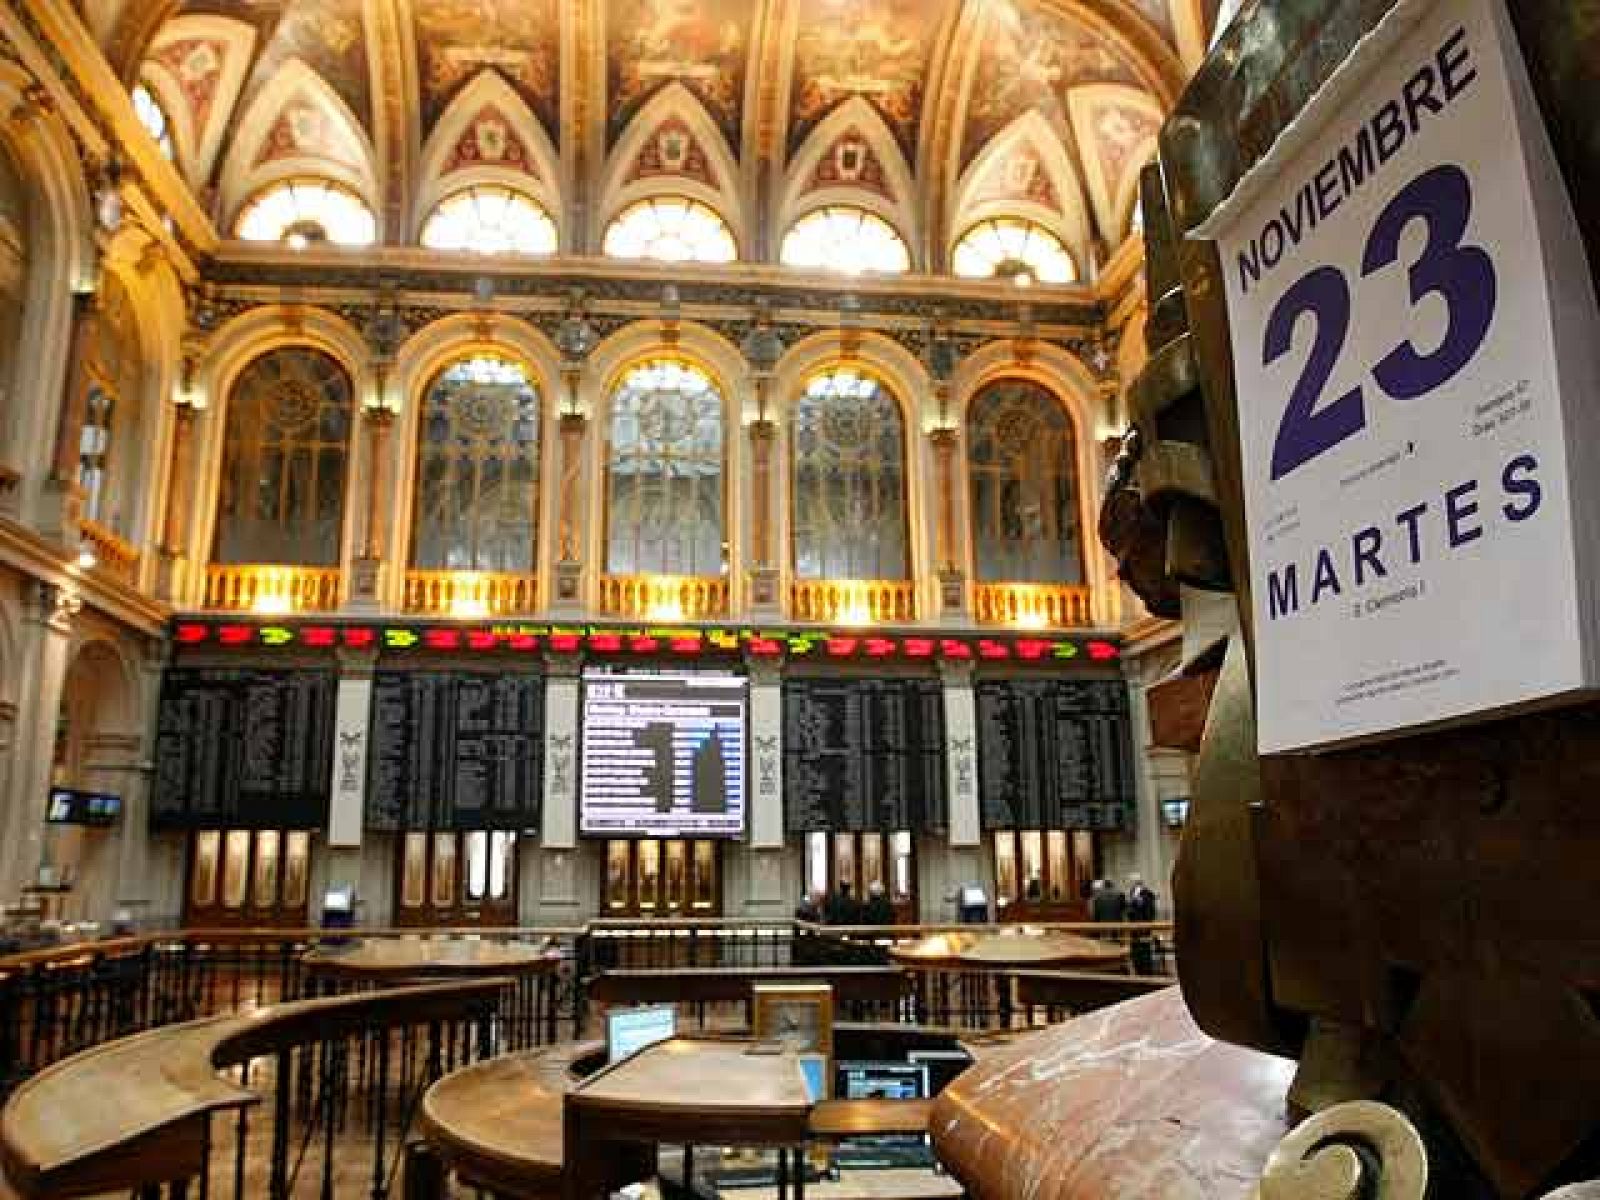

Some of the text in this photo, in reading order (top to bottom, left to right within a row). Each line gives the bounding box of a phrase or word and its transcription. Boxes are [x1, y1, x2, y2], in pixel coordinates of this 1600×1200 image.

[1237, 26, 1477, 292] NOVIEMBRE
[1263, 164, 1496, 480] 23
[1268, 455, 1541, 620] MARTES
